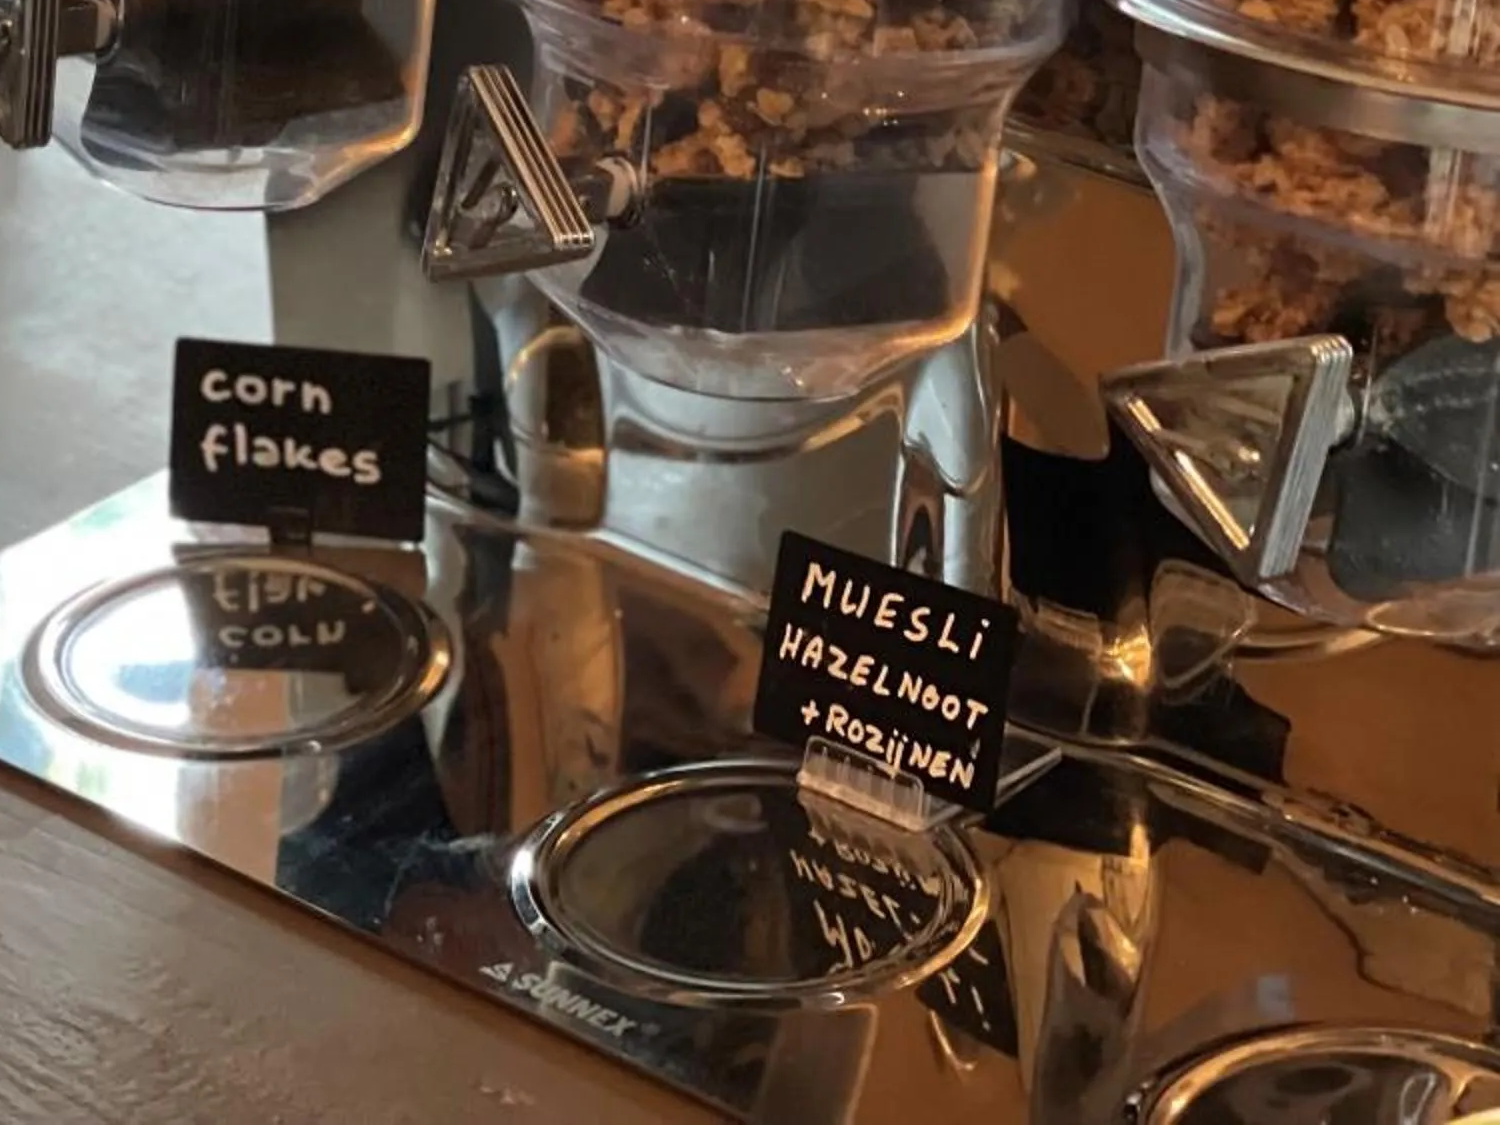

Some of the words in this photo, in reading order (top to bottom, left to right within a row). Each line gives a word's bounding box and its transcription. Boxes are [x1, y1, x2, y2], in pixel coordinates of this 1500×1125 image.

[201, 369, 332, 414] corn
[201, 423, 382, 484] flakes
[779, 623, 989, 729] HAZELNOOT
[512, 972, 638, 1037] SUNNEX
